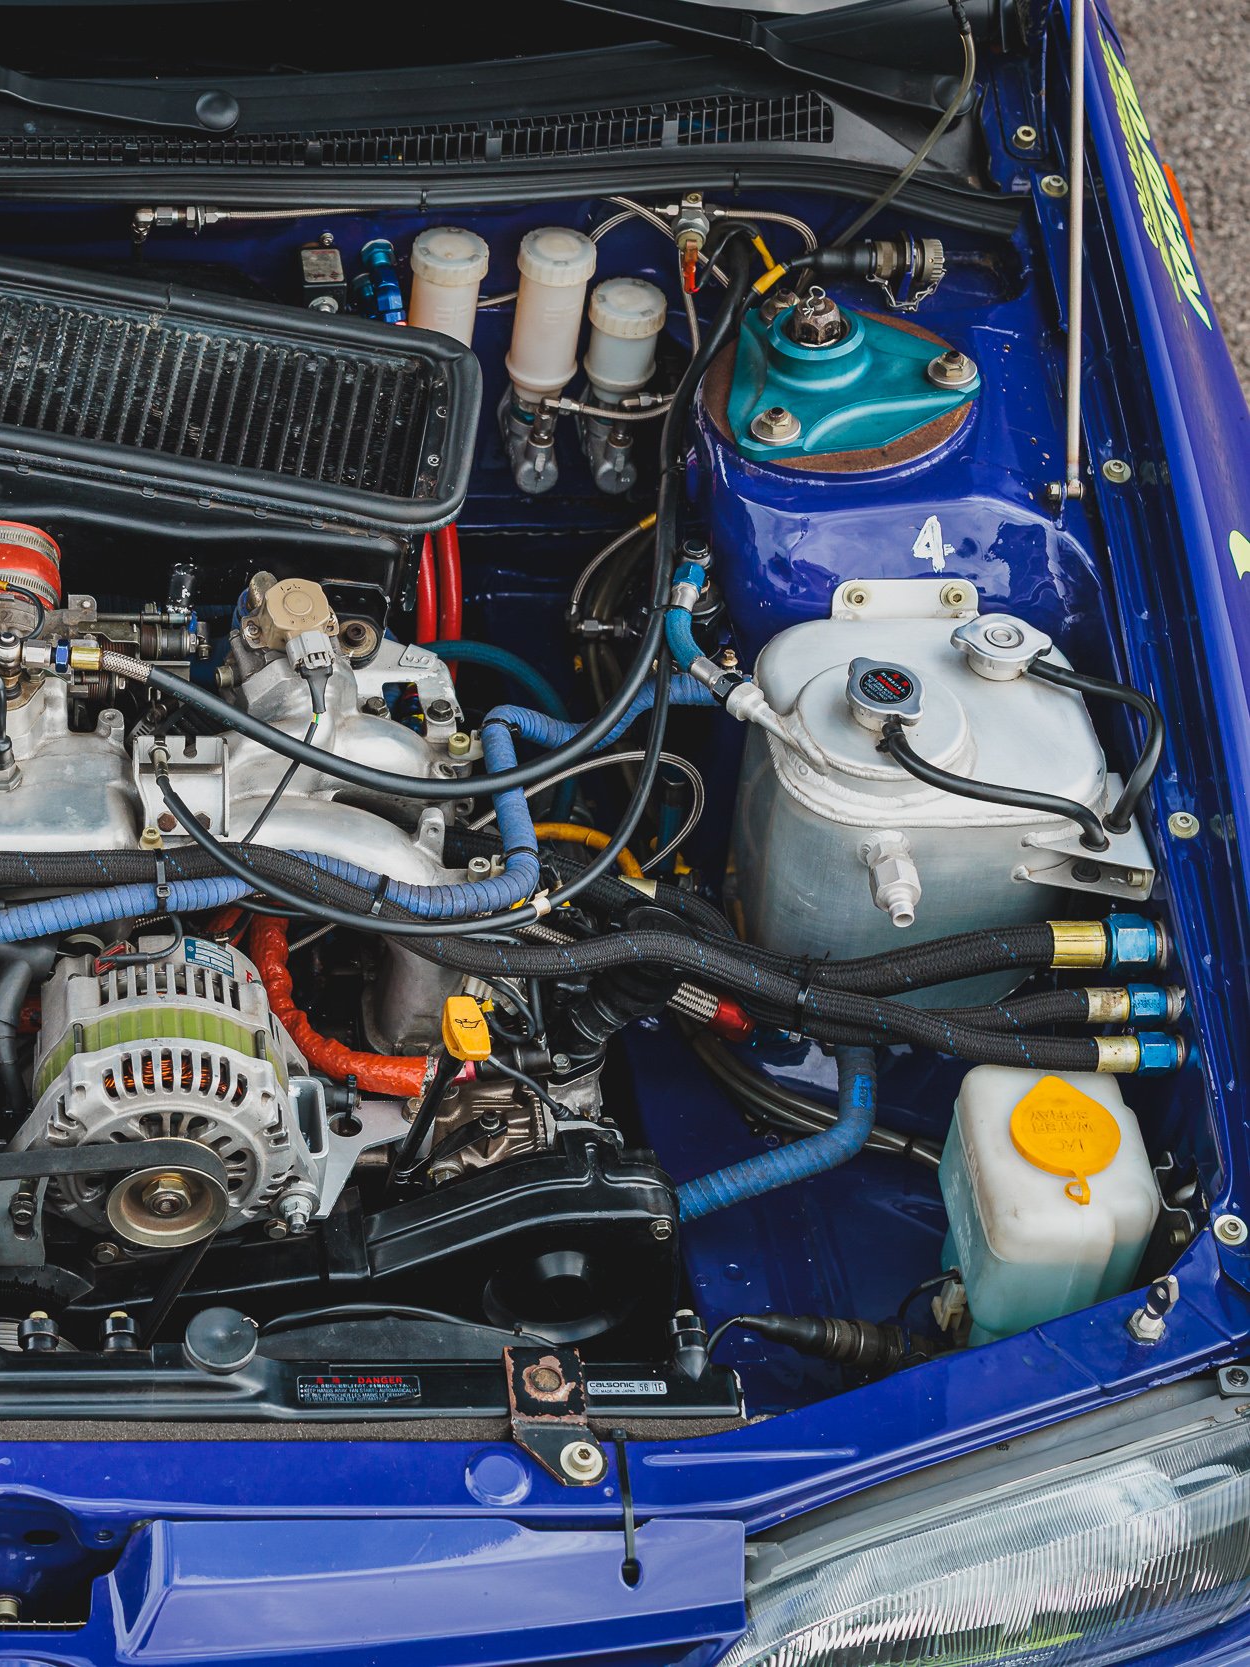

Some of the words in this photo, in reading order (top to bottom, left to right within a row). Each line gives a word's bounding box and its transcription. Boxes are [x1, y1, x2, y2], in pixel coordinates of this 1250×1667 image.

[1106, 40, 1213, 330] REPSOL
[1125, 142, 1158, 248] COLIN
[357, 1376, 403, 1384] DANGER
